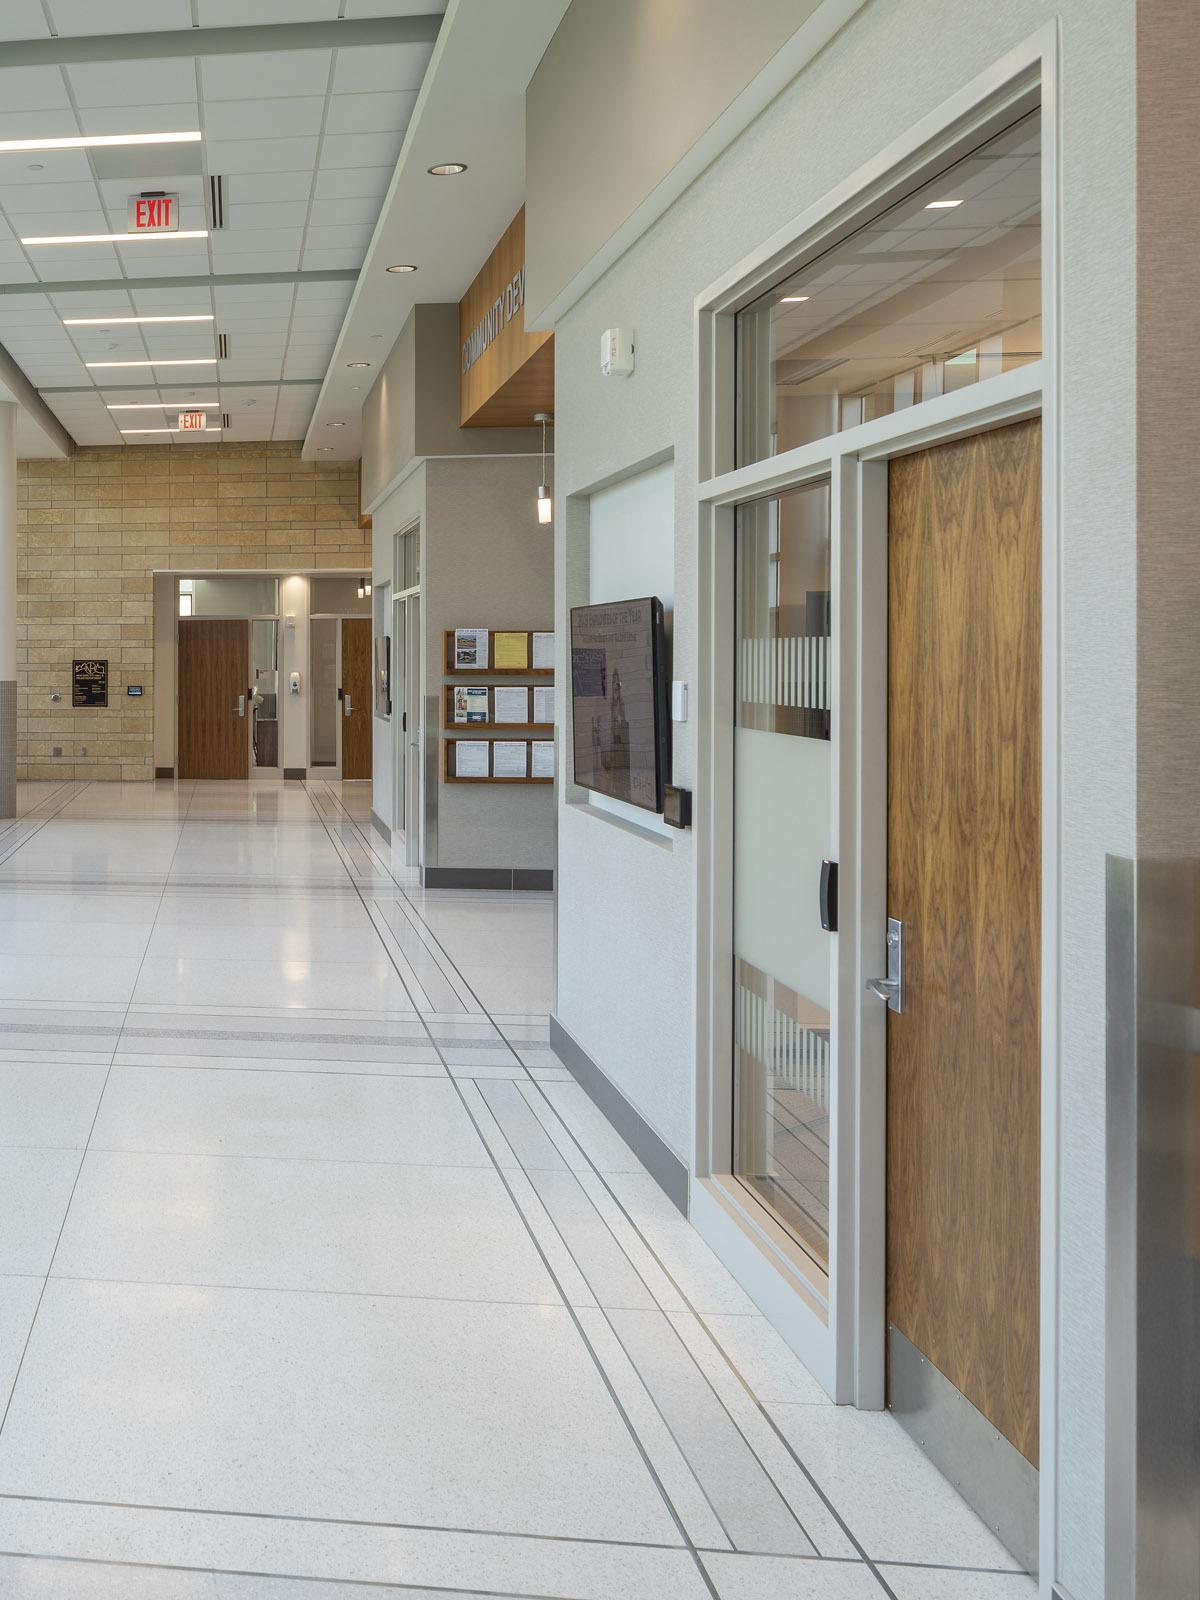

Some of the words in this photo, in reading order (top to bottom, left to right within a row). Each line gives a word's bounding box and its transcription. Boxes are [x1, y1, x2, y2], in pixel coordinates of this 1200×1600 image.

[136, 200, 172, 228] EXIT
[462, 291, 505, 375] COMMUNITY
[183, 413, 202, 429] EXIT
